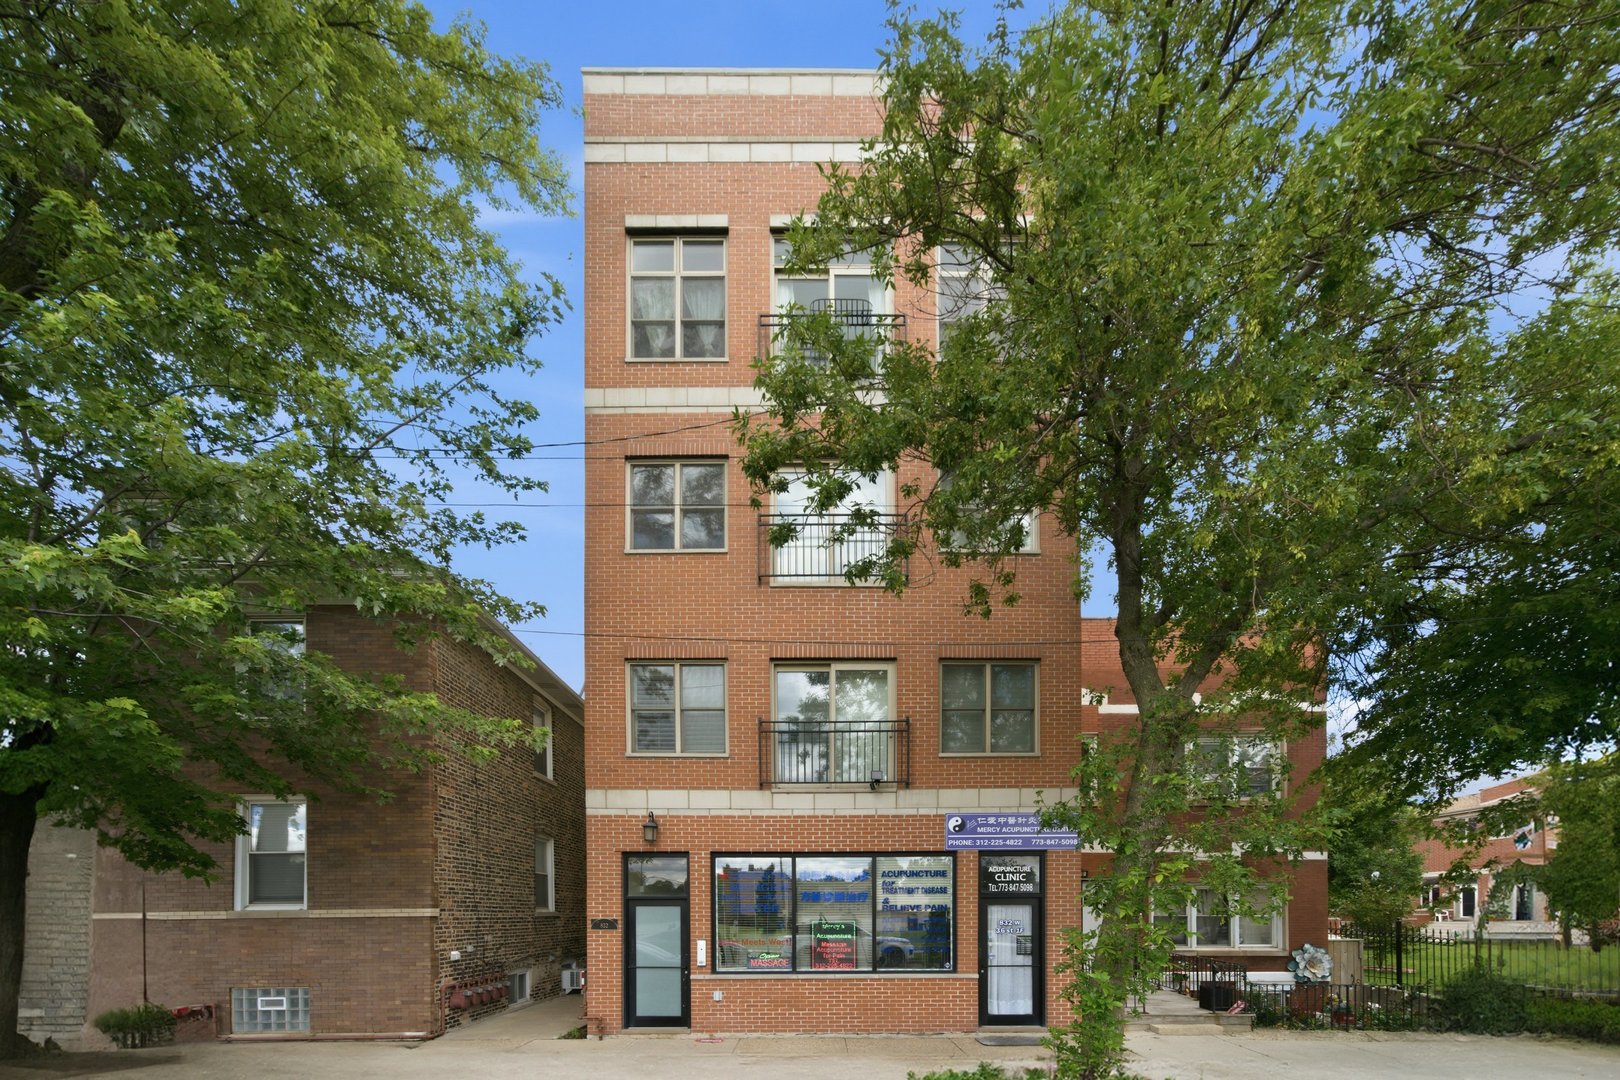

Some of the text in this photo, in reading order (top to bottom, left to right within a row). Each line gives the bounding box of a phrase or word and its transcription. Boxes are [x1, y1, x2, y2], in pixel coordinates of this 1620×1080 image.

[881, 870, 947, 878] ACUPUNCTURE
[994, 873, 1027, 881] CLINIC
[882, 904, 948, 912] RELIEVE PAIN
[750, 958, 788, 967] MASSAGE
